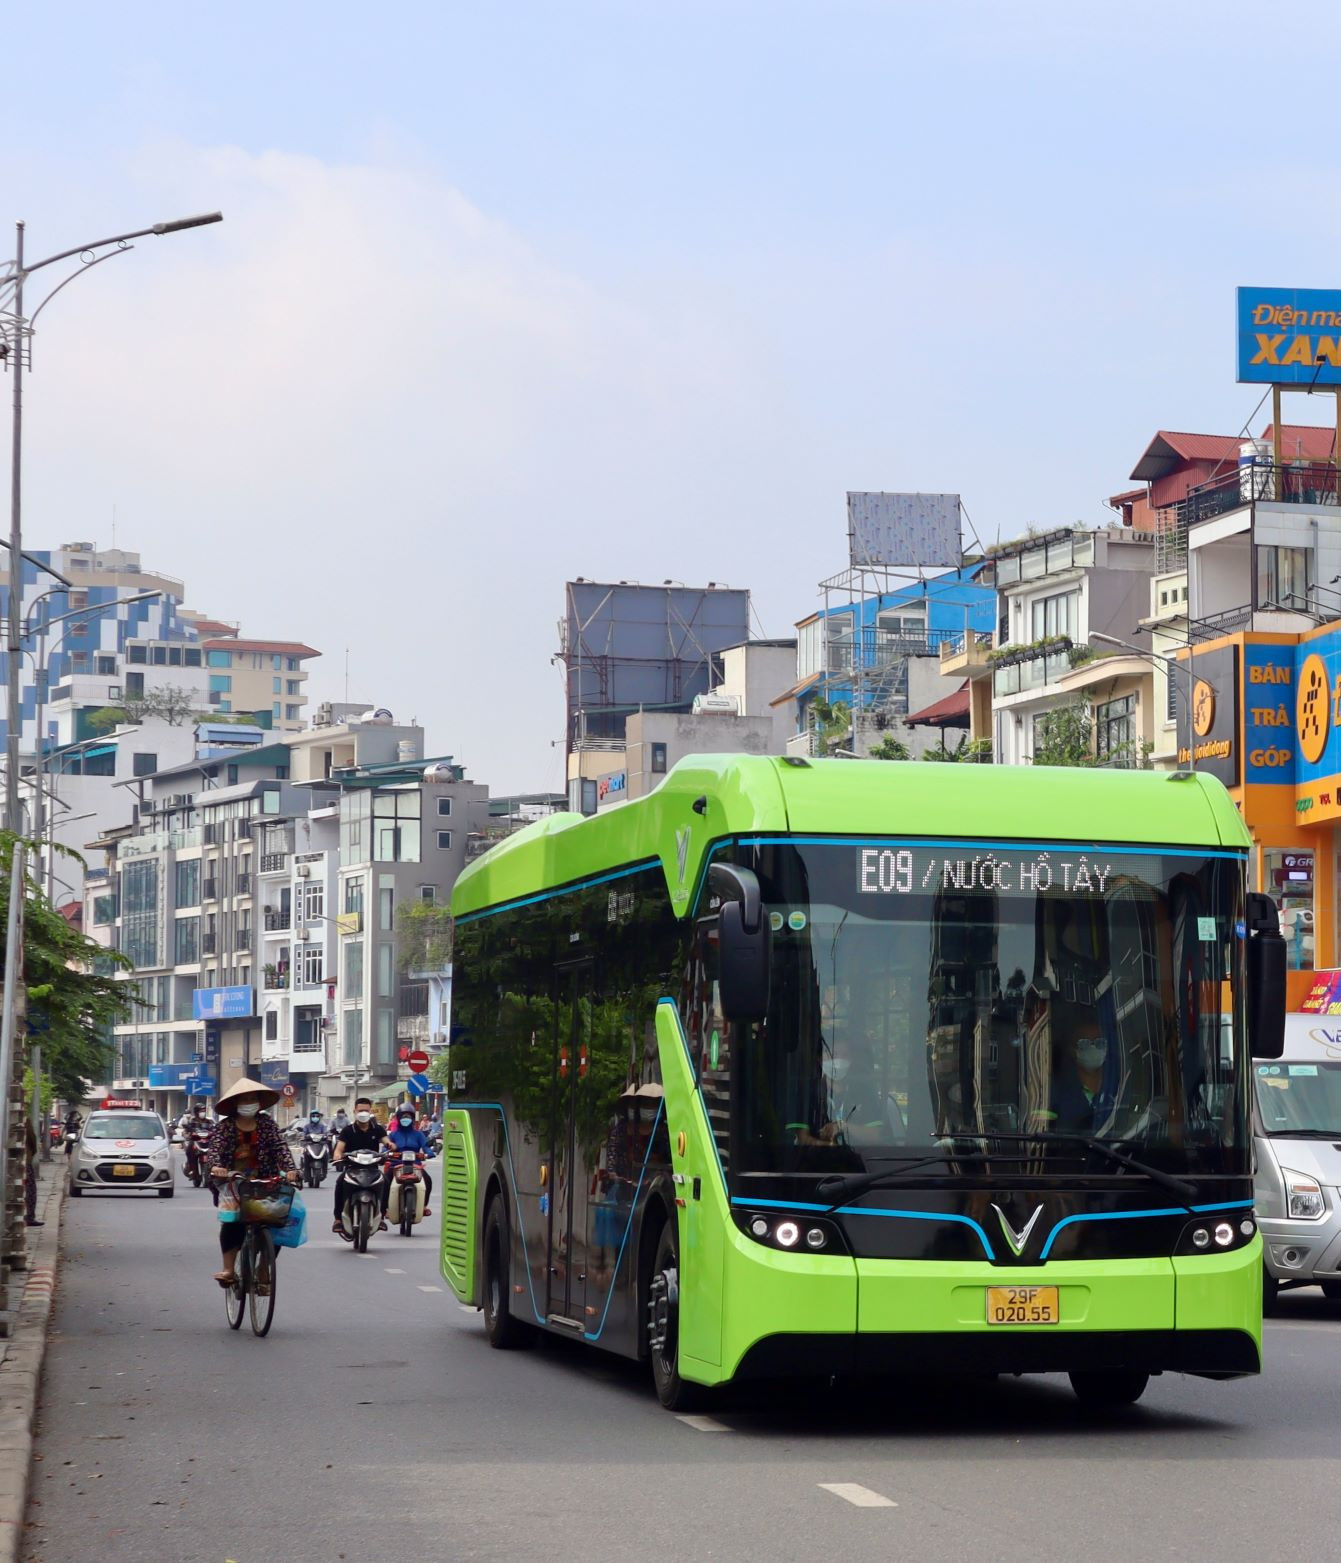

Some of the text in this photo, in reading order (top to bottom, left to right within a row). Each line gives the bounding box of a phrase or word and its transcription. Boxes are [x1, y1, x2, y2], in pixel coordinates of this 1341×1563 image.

[1252, 304, 1307, 331] Điện
[1250, 662, 1290, 684] BÁN
[1251, 703, 1290, 727] TRẢ
[1178, 740, 1231, 764] theioididong
[1250, 746, 1291, 767] GÓP
[861, 849, 913, 893] E09
[943, 852, 1013, 890] NƯỚC
[1060, 855, 1112, 893] TÂY
[1008, 1289, 1037, 1304] 29F
[995, 1306, 1051, 1322] 020.55
